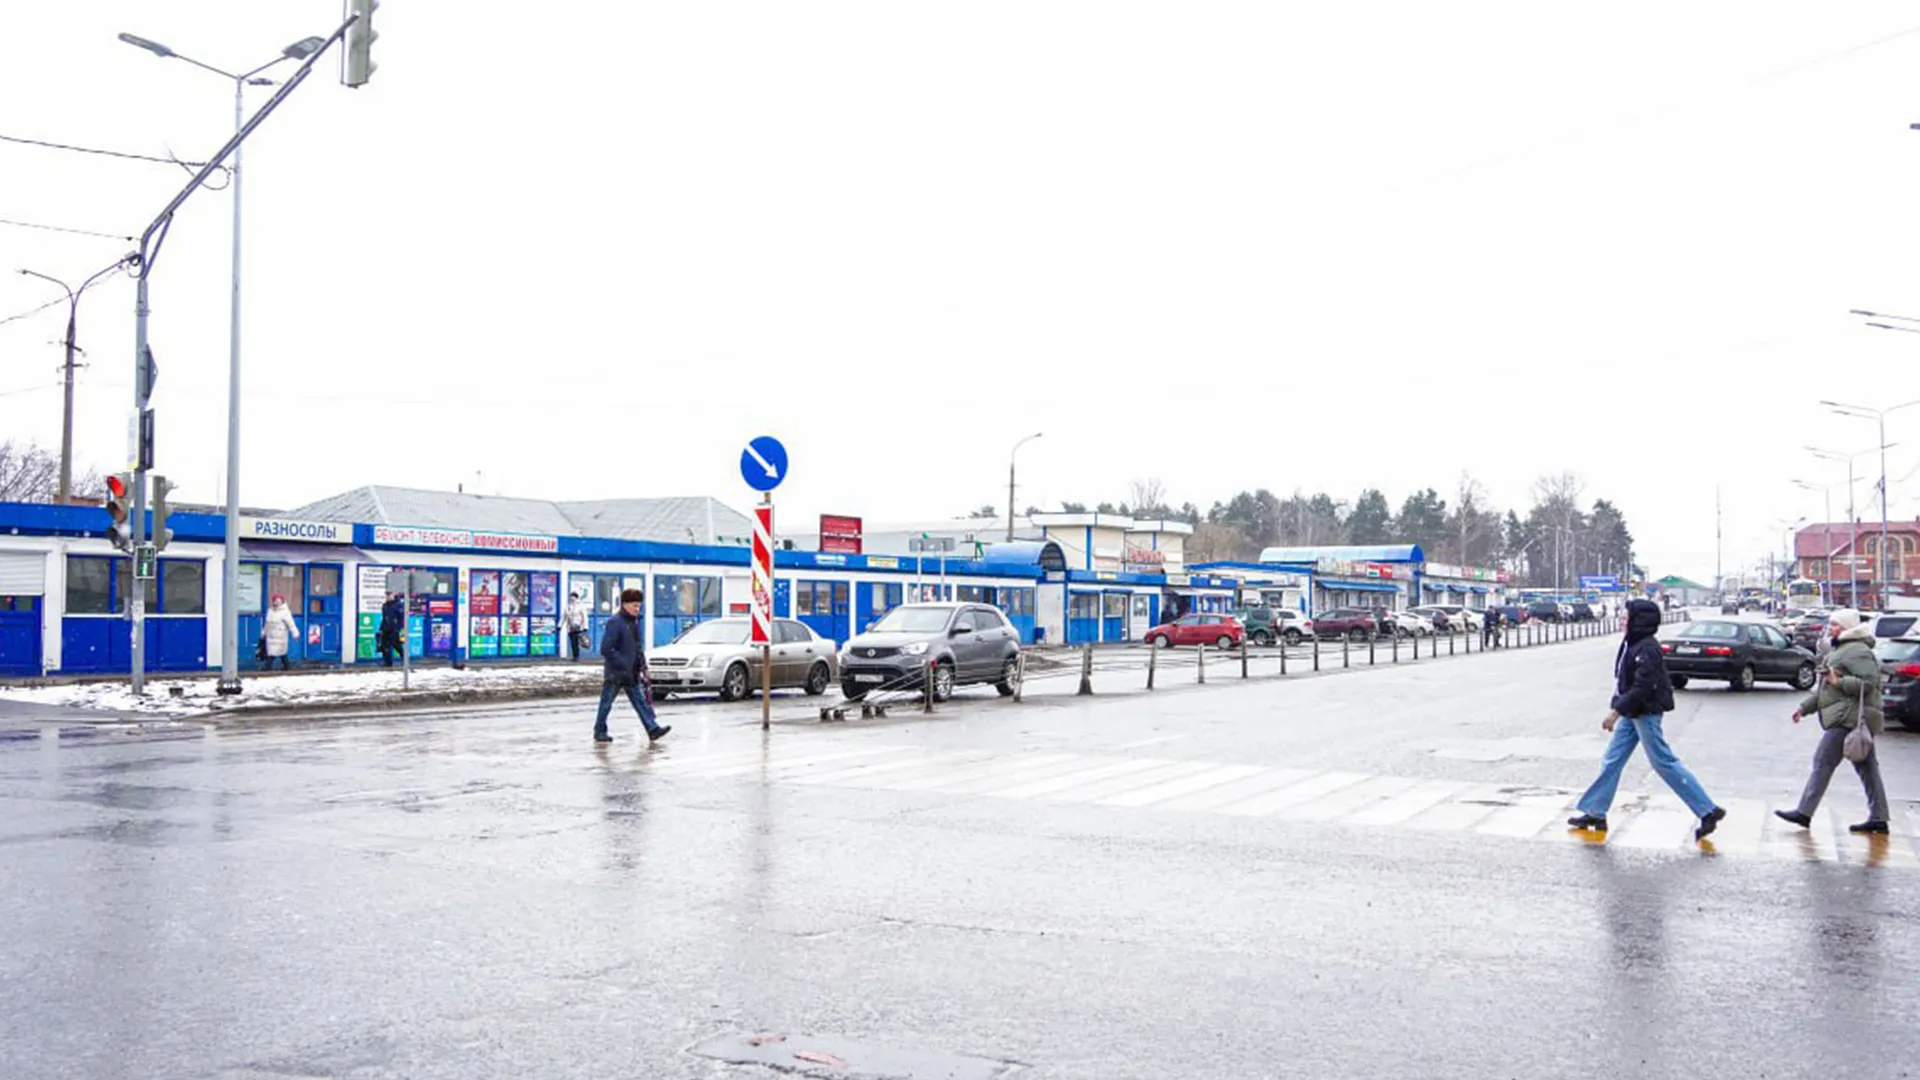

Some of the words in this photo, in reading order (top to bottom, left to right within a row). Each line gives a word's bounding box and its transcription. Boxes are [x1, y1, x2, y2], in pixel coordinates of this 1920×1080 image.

[255, 521, 337, 539] РАЗНОСОЛЫ
[375, 528, 414, 542] РЕМОНТ
[418, 530, 471, 545] ТЕЛЕФОНОВ
[473, 535, 557, 551] КОМИССИОННЫЙ
